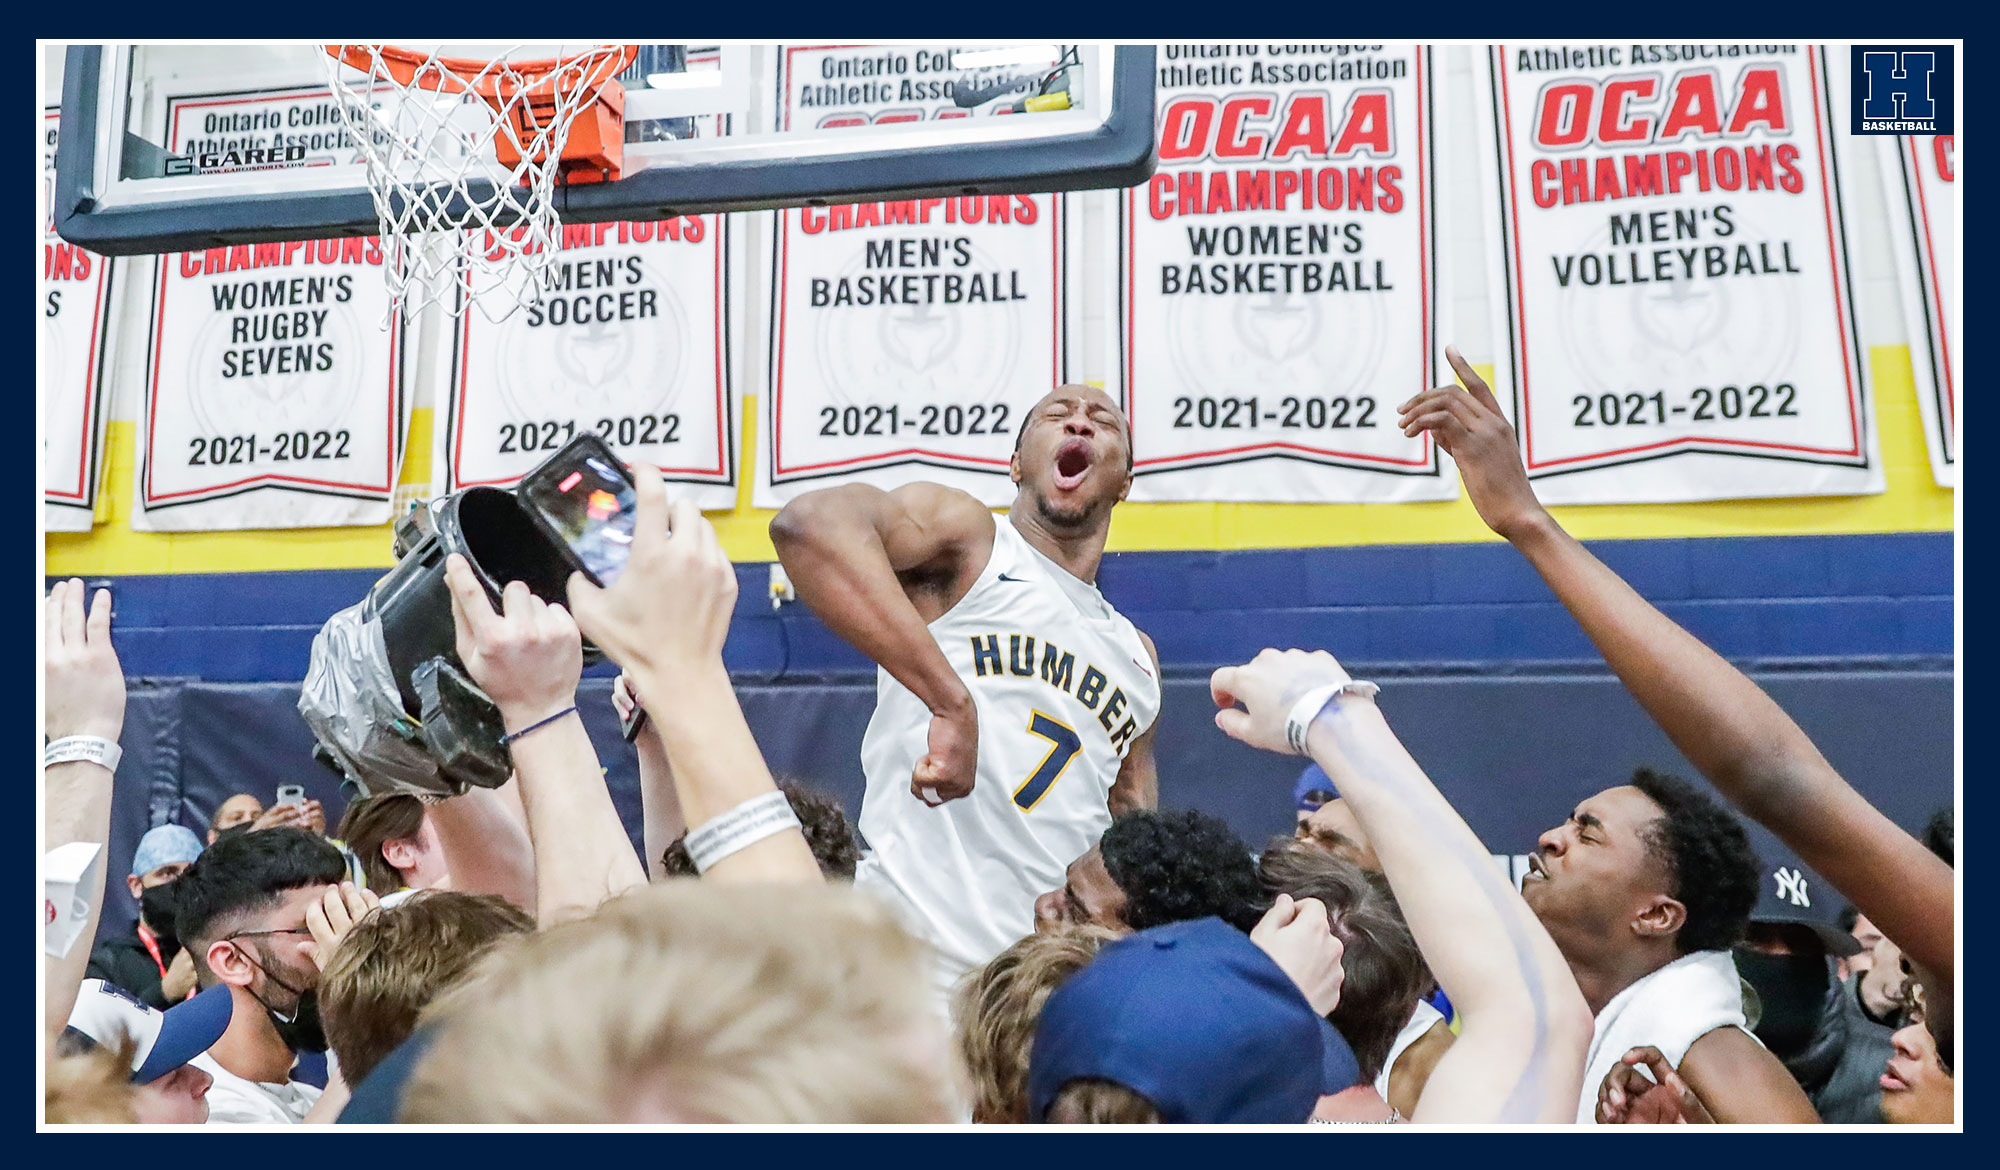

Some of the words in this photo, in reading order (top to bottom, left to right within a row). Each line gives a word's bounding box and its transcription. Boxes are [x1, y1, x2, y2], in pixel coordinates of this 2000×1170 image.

[821, 52, 908, 80] Ontario
[1160, 62, 1242, 88] thletic
[1250, 55, 1408, 85] Association
[1517, 45, 1622, 72] Athletic
[801, 77, 893, 108] Athletic
[1536, 66, 1791, 148] OCAA
[204, 109, 282, 134] Ontario
[287, 102, 382, 128] Colle
[1157, 92, 1392, 162] OCAA
[199, 145, 306, 169] GARED
[273, 127, 392, 152] Associao
[1149, 165, 1404, 220] CHAMPIONS
[1531, 143, 1804, 209] CHAMPIONS
[1187, 223, 1362, 257] WOMEN'S
[1610, 205, 1735, 246] MEN'S
[866, 237, 971, 270] MEN'S
[1552, 240, 1800, 287] VOLLEYBALL
[545, 255, 643, 293] MEN'S
[811, 270, 1027, 308] BASKETBALL
[1162, 260, 1393, 295] BASKETBALL
[211, 275, 353, 312] WOMEN'S
[527, 289, 658, 327] SOCCER
[231, 310, 329, 344] RUGBY
[222, 344, 334, 379] SEVENS
[819, 404, 1010, 437] 2021-2022
[1173, 397, 1377, 429] 2021-2022
[1573, 383, 1799, 428] 2021-2022
[188, 430, 351, 466] 2021-2022
[499, 414, 681, 454] 20212022
[970, 633, 1137, 756] HUMBER
[1011, 707, 1083, 814] 7
[1772, 866, 1811, 908] NY
